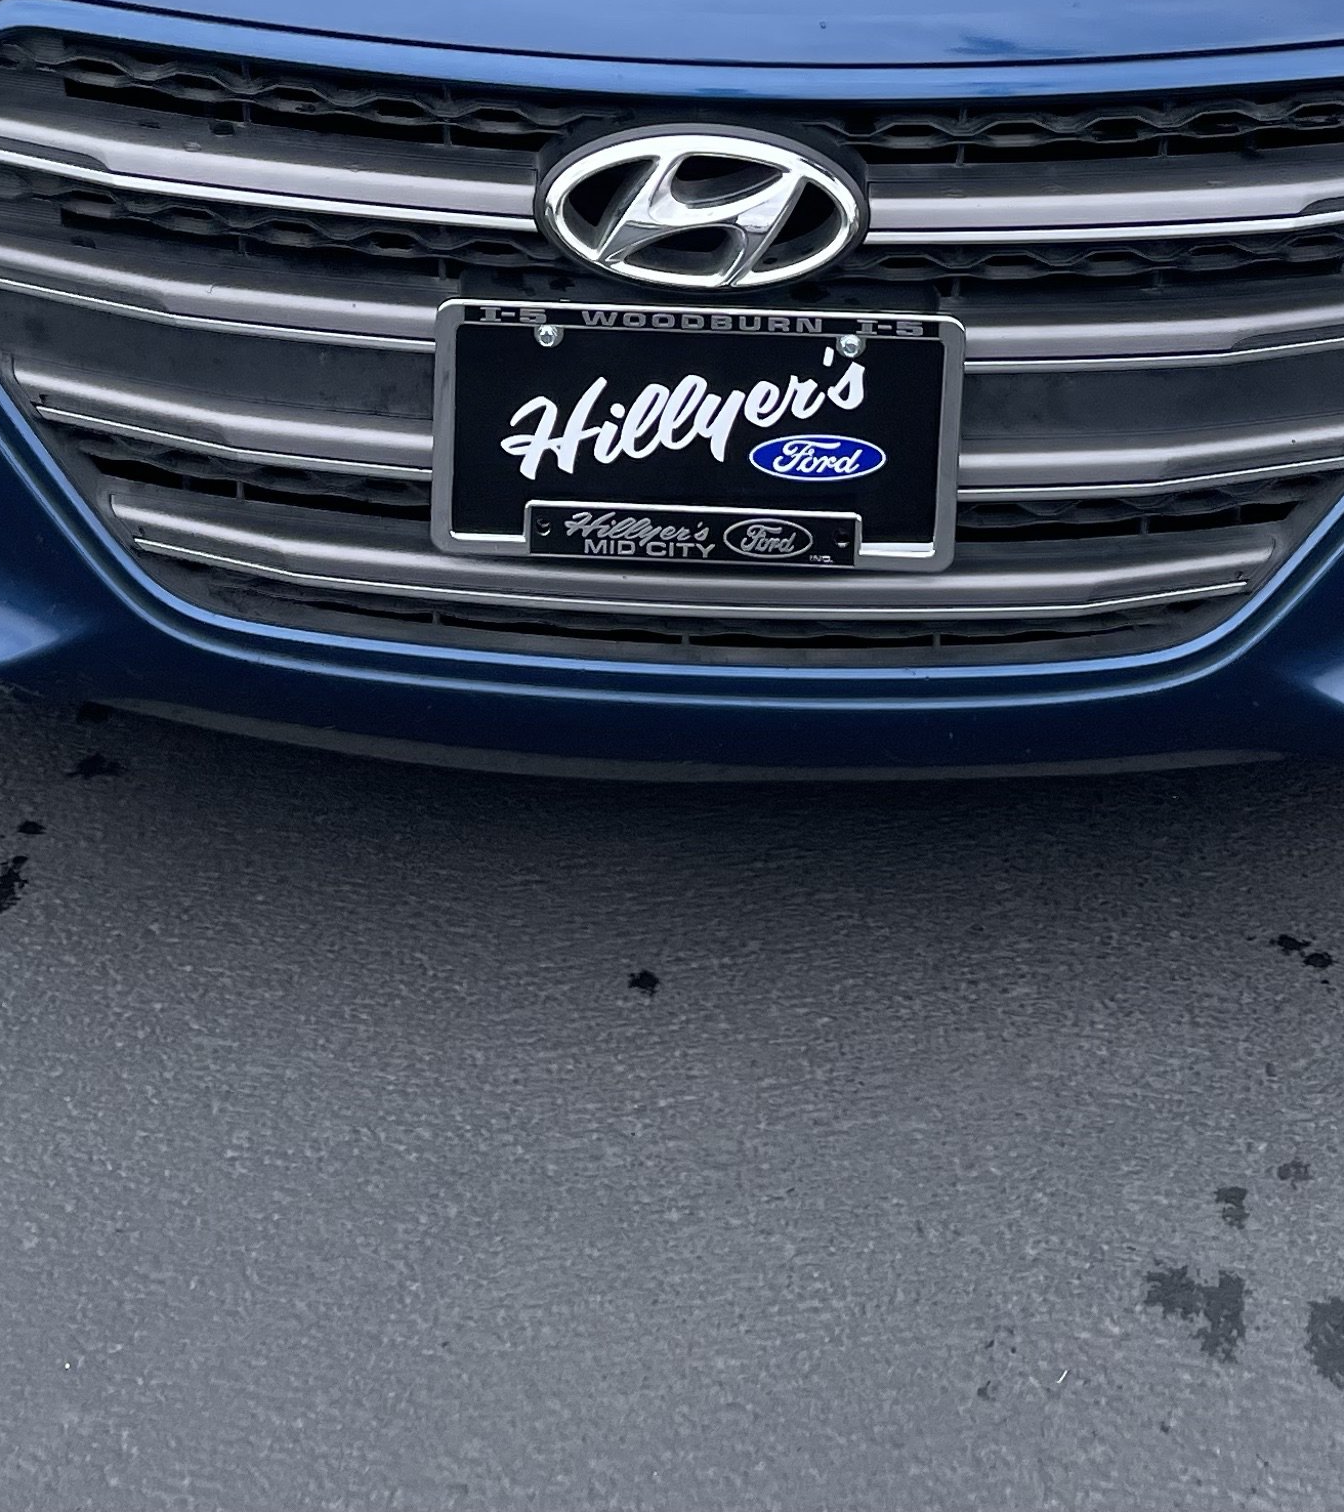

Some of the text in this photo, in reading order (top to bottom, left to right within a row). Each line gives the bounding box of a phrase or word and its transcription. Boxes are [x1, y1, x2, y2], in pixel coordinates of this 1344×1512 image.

[479, 306, 924, 337] I-5 WOODBURN I-5
[500, 345, 866, 481] Hillyer's
[772, 438, 865, 476] Ford
[564, 511, 710, 547] Hillyer's
[740, 524, 797, 554] Ford
[583, 538, 716, 558] MID CITY
